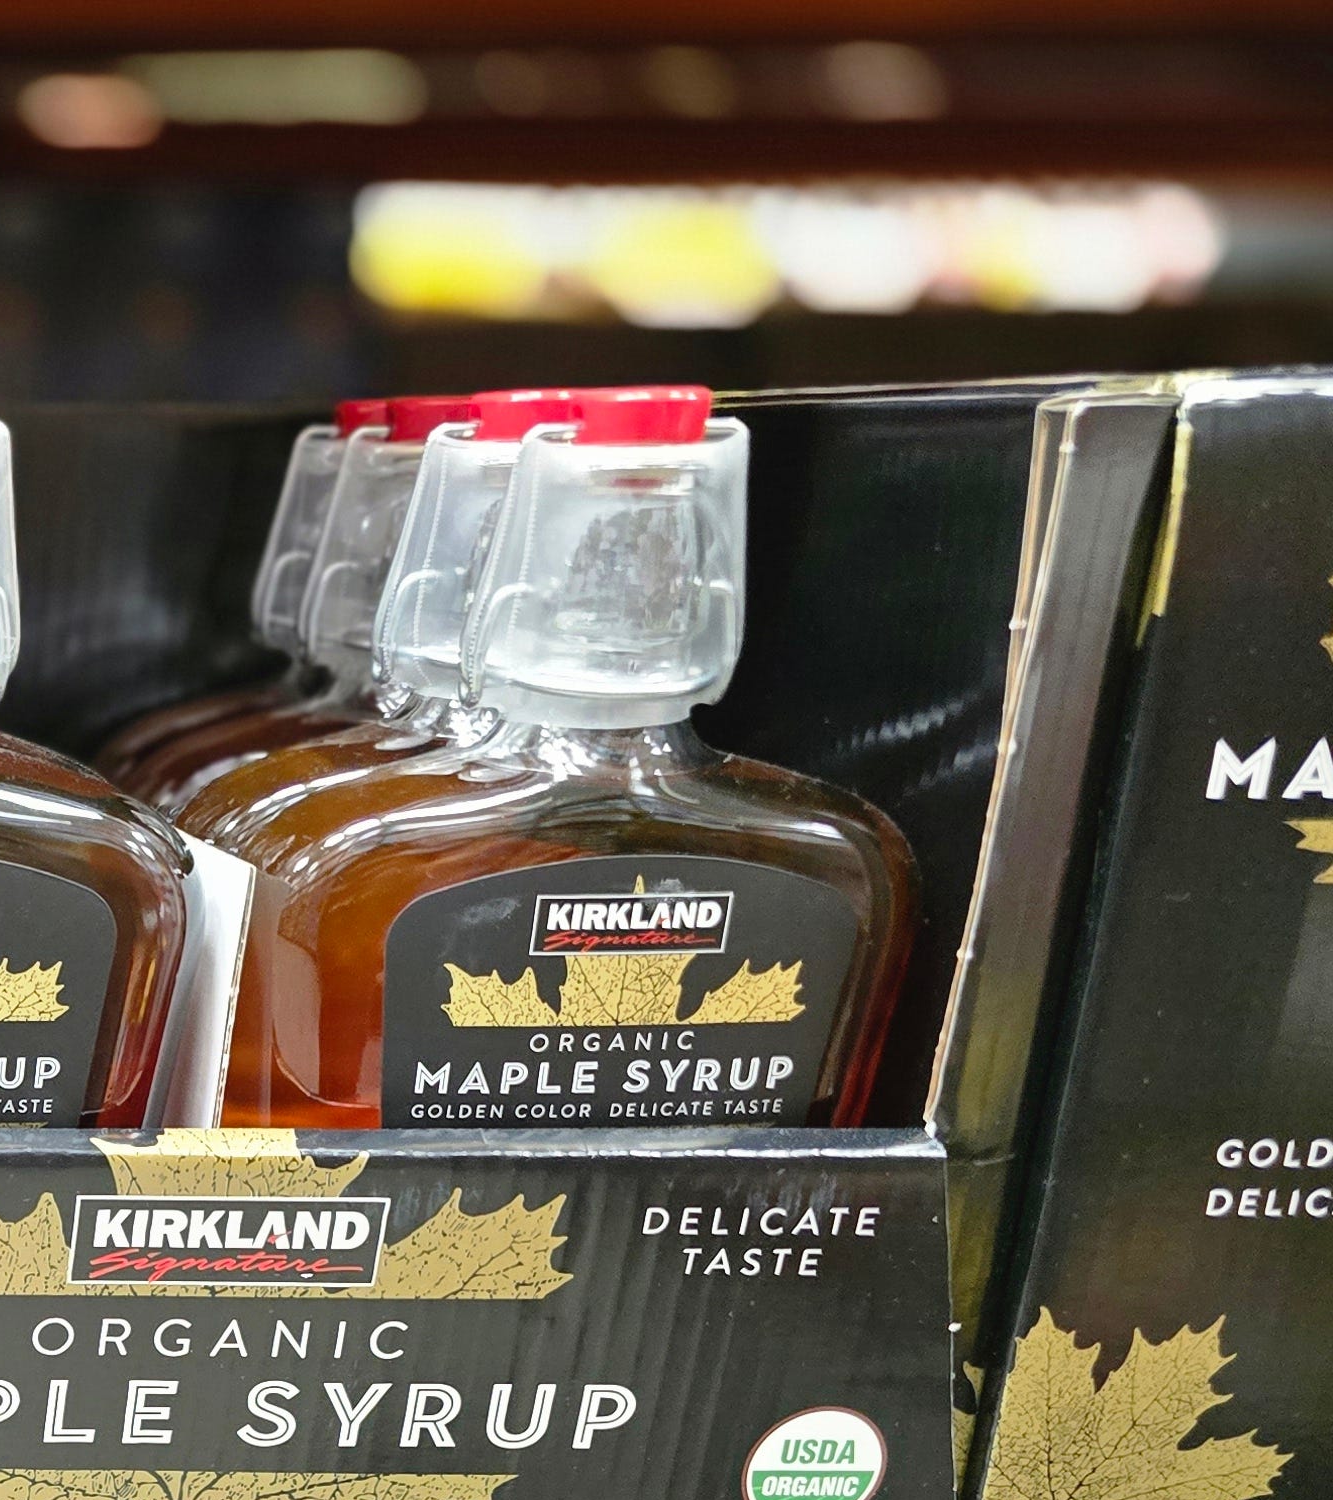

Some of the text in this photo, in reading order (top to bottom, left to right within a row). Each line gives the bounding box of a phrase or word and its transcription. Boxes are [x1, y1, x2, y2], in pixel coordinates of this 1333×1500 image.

[546, 902, 721, 930] KIRKLAND
[543, 931, 716, 954] Signature
[529, 1032, 695, 1053] ORGANIC
[414, 1056, 793, 1094] MAPLE SYRUP
[411, 1099, 782, 1119] GOLDEN COLOR DELICATE TASTE
[1215, 1138, 1333, 1169] GOLD
[1206, 1188, 1333, 1218] DELIC
[91, 1209, 371, 1250] KIRKLAND
[642, 1208, 880, 1238] DELICATE
[89, 1248, 363, 1282] Signature
[682, 1248, 822, 1276] TASTE
[32, 1318, 409, 1360] ORGANIC
[238, 1381, 636, 1450] SYRUP
[780, 1440, 856, 1466] USDA
[759, 1474, 859, 1500] ORGANIC
